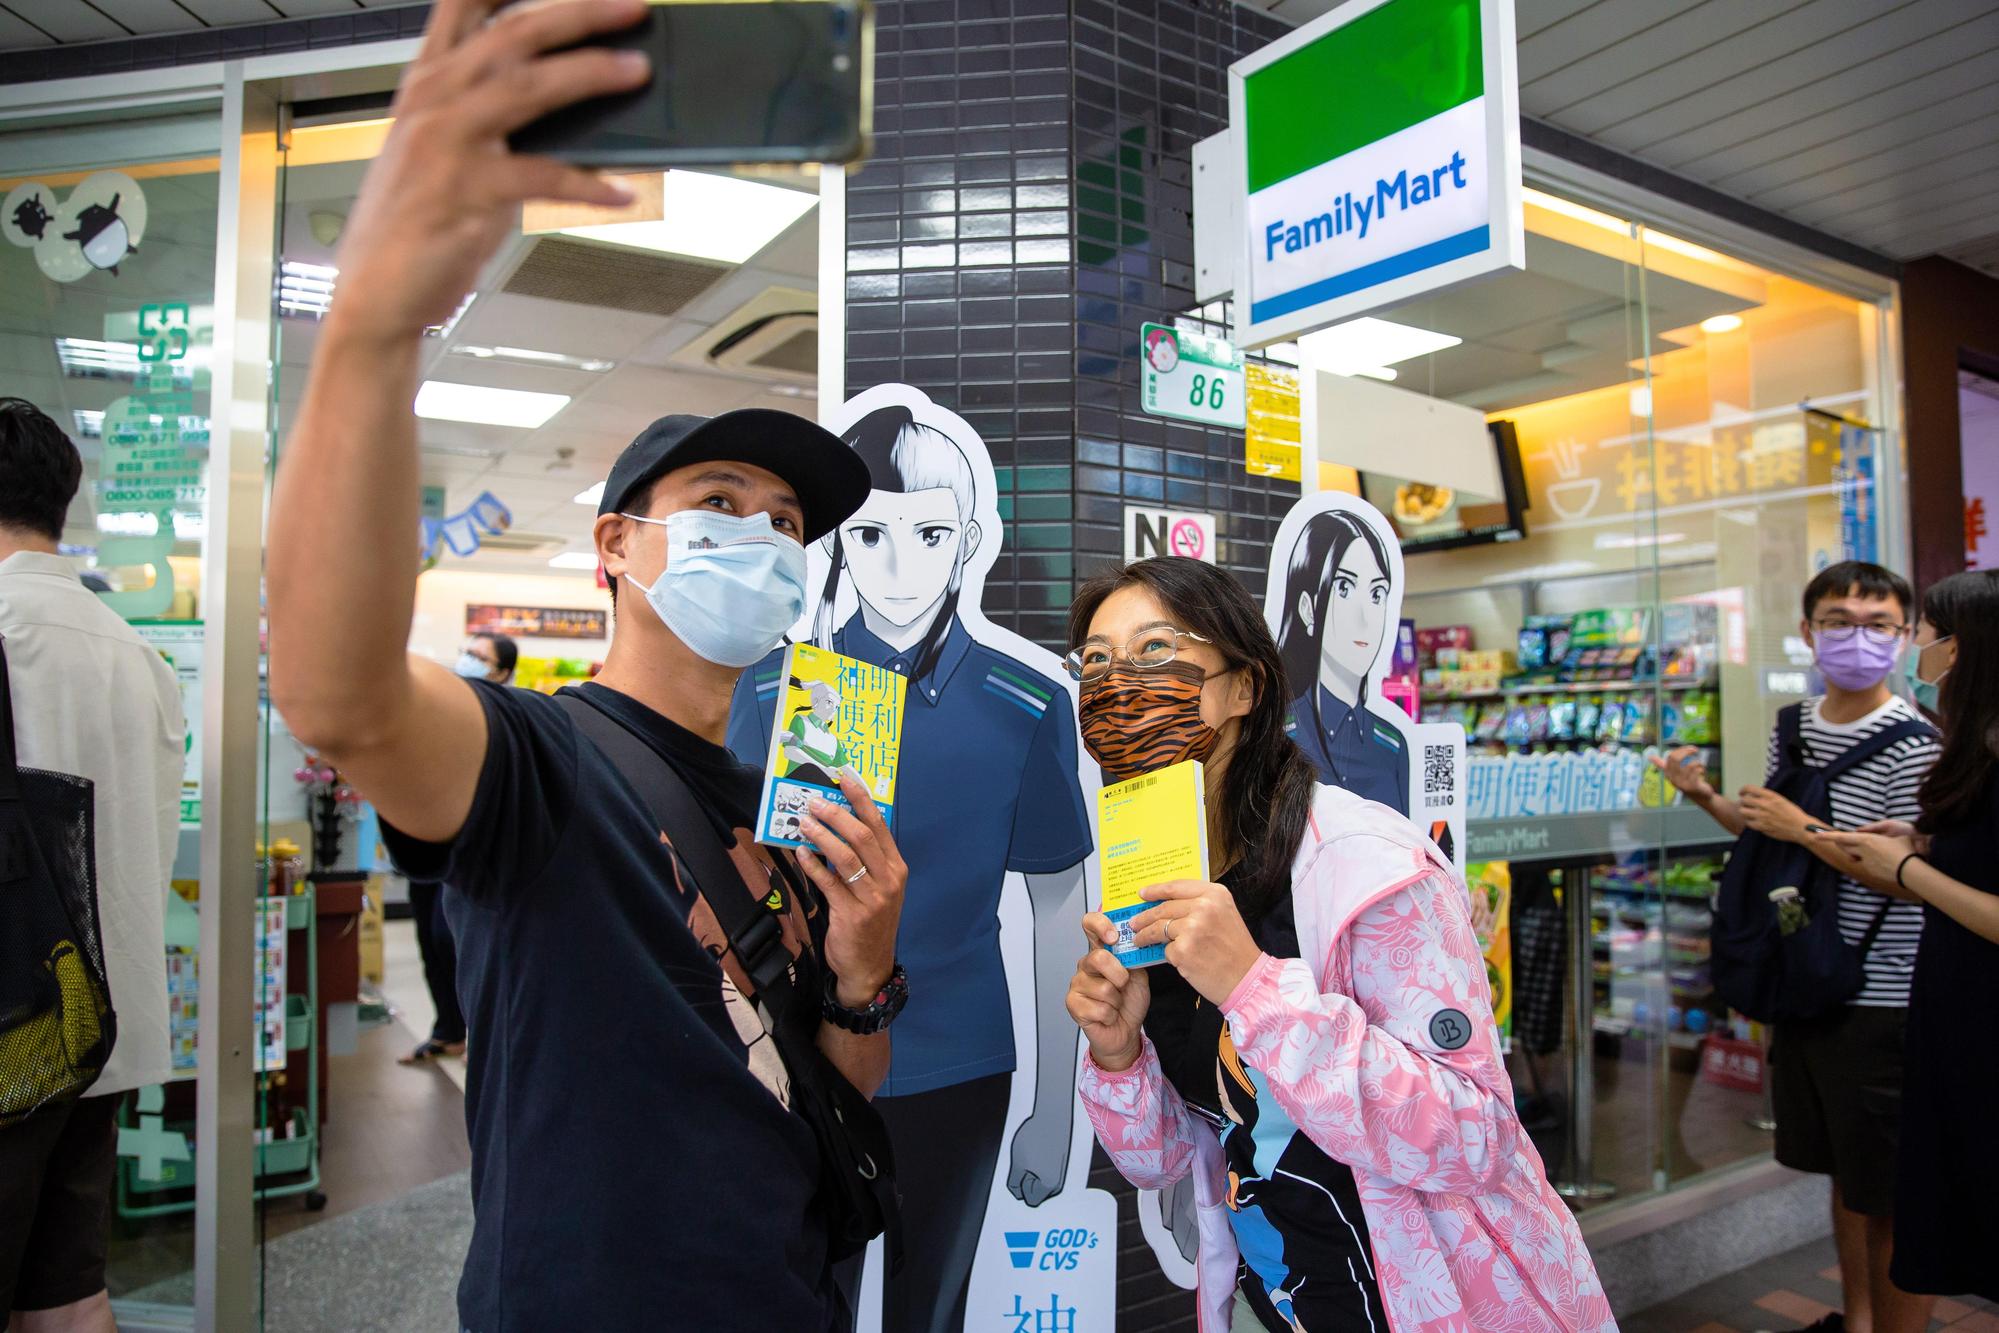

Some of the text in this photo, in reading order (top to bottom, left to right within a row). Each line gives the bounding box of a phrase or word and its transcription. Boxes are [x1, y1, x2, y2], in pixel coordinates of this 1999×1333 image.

[1266, 151, 1467, 262] FamilyMart
[1189, 374, 1225, 410] 86
[1467, 756, 1641, 819] 明便利商店
[1467, 827, 1549, 854] FamilyMart
[1044, 1229, 1099, 1249] GOD's
[1039, 1251, 1080, 1271] CVS
